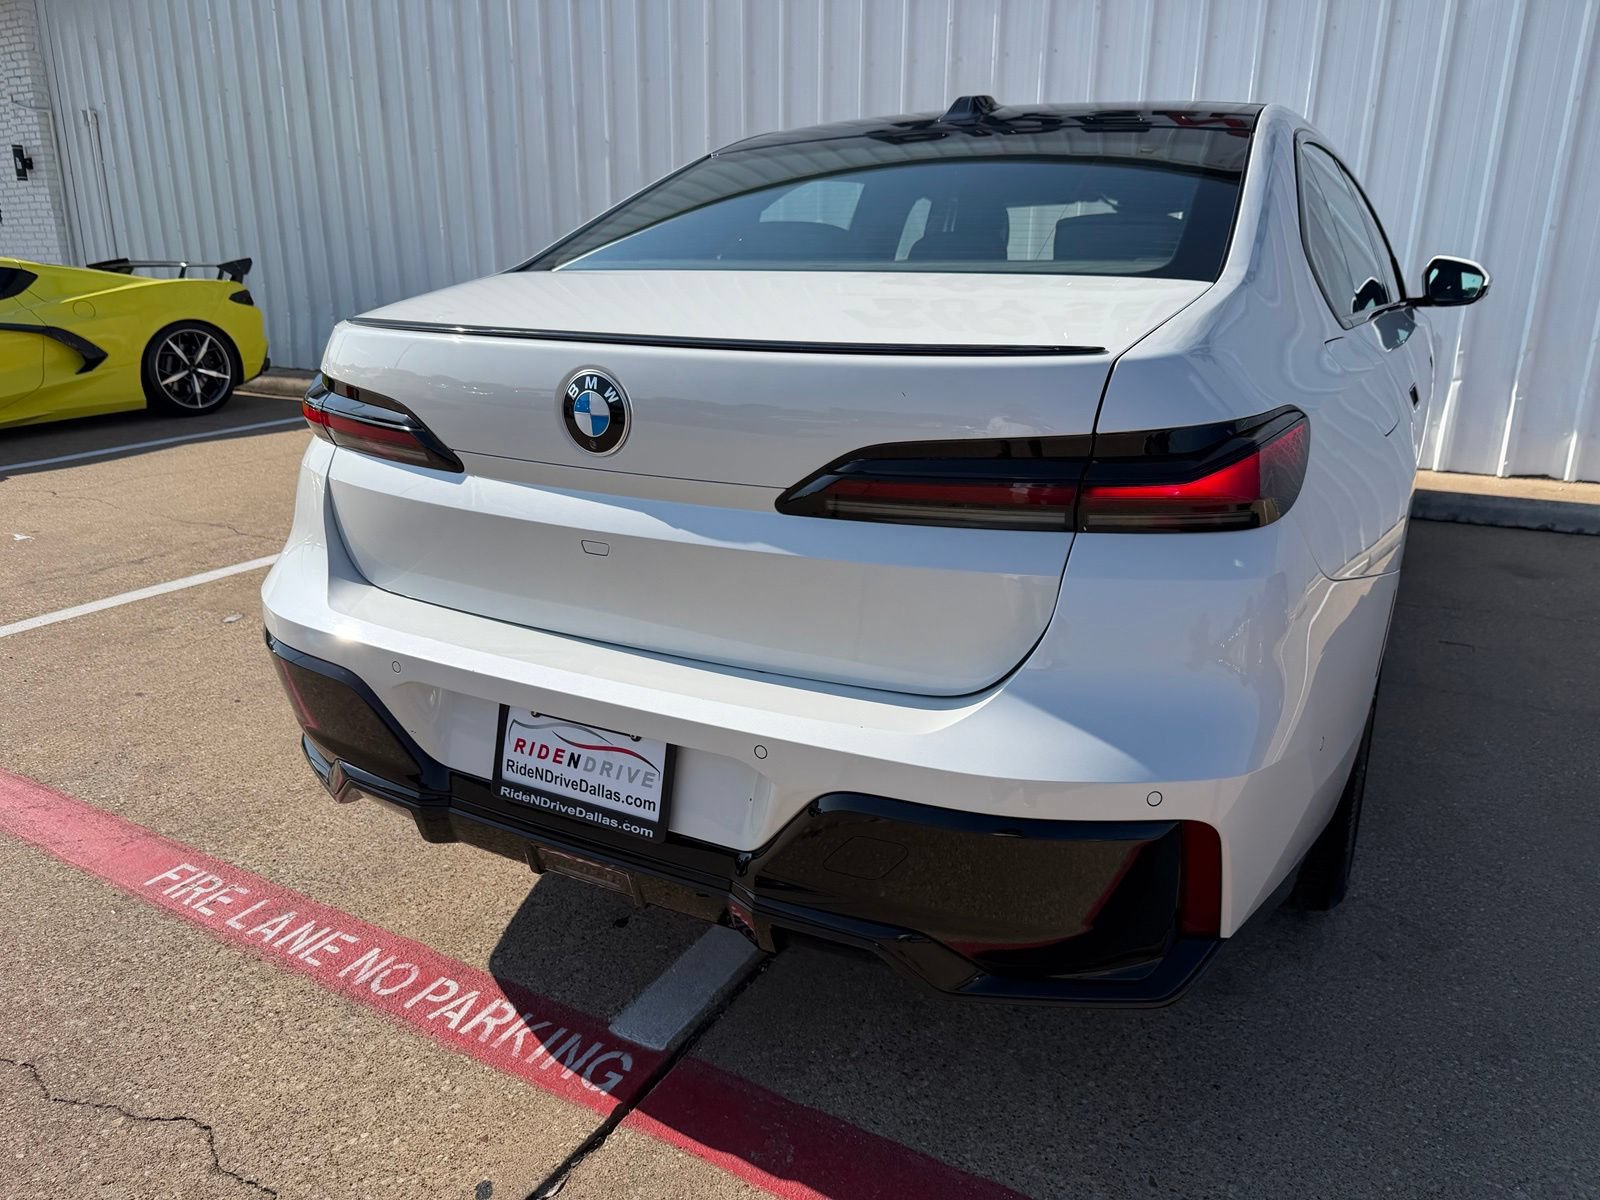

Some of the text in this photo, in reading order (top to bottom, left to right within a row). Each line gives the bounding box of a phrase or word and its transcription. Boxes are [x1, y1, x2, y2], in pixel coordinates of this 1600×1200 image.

[568, 376, 619, 403] BMW
[506, 759, 656, 812] RideNDriveDallas.com
[500, 786, 653, 838] RideNDriveDallas.com
[144, 863, 633, 1096] FIRE LANE NO PARKING
